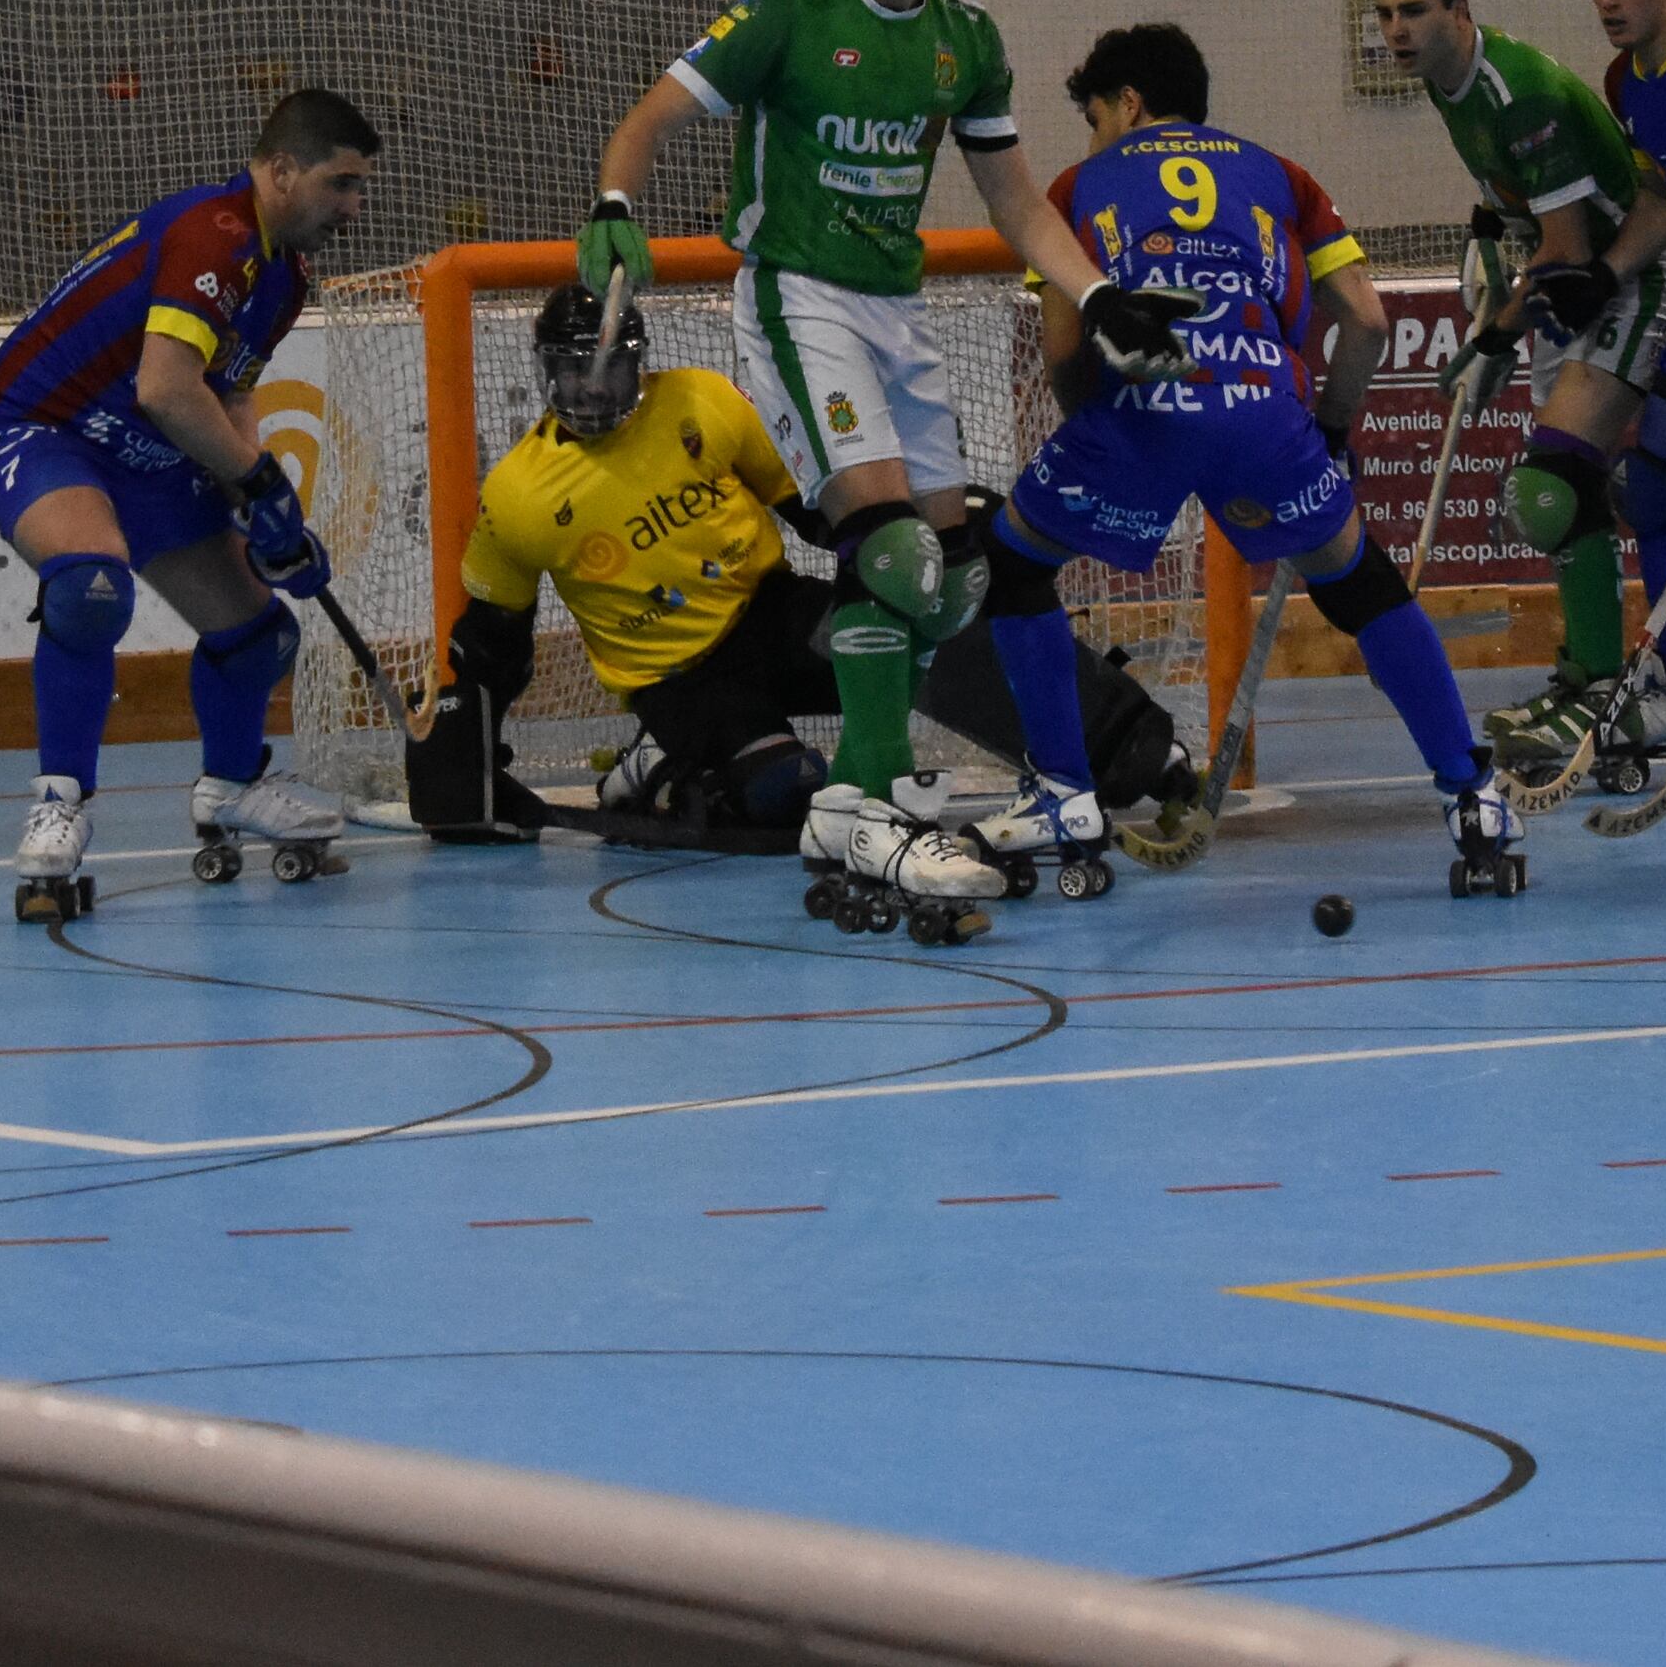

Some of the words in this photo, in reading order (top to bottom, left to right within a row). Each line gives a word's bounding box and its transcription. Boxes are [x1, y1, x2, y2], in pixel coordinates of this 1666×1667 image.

[1159, 156, 1218, 232] 9
[1361, 410, 1443, 431] Avenida
[1363, 454, 1414, 476] Muro
[1449, 452, 1505, 480] Alcoy
[625, 478, 729, 552] aitex
[1361, 502, 1396, 522] Tel.
[1403, 500, 1426, 521] 96
[1444, 499, 1479, 519] 530
